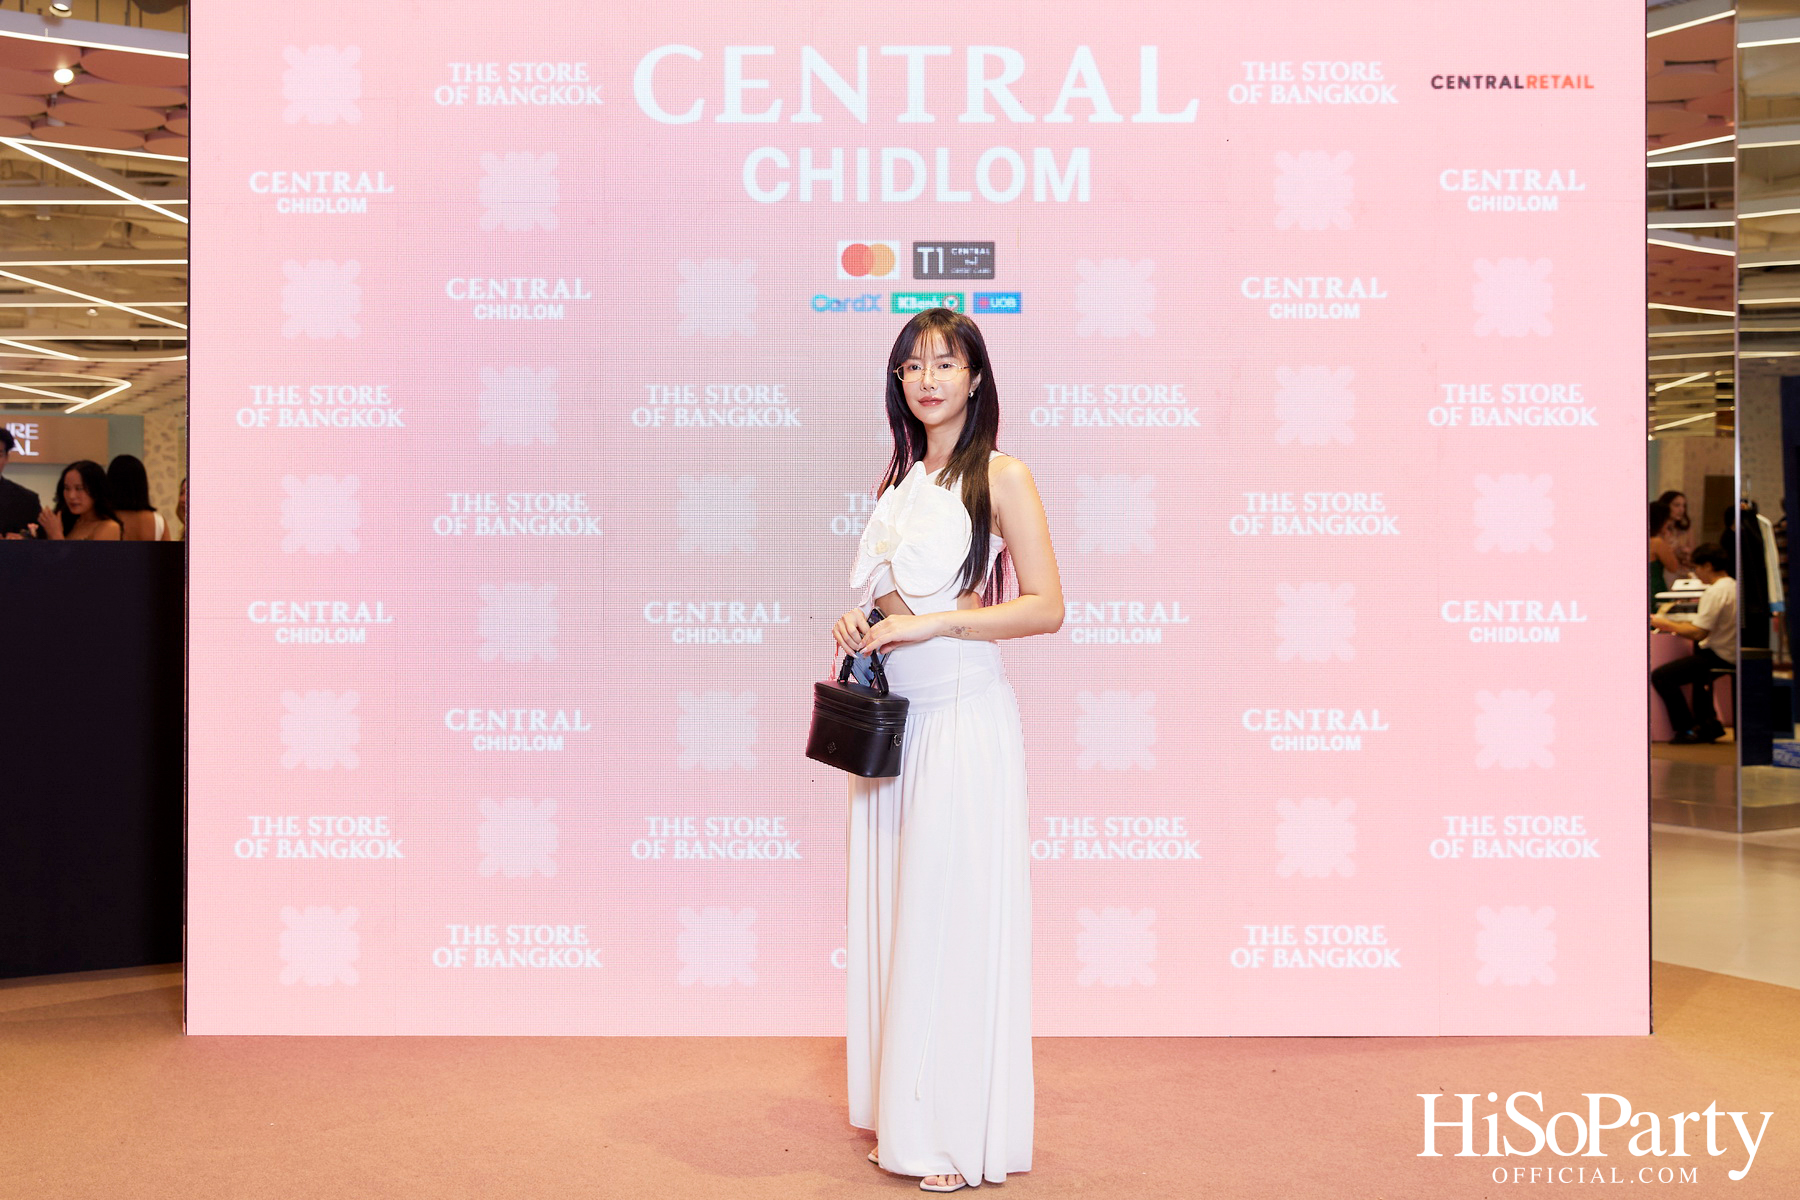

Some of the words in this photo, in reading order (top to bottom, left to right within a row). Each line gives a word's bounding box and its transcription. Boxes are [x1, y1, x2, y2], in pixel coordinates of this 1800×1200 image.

[449, 63, 501, 82] THE
[507, 62, 590, 82] STORE
[1242, 61, 1295, 82] THE
[1301, 61, 1385, 82] STORE
[633, 44, 1199, 125] CENTRAL
[1431, 75, 1595, 90] CENTRALRETAIL
[433, 85, 469, 106] OF
[475, 84, 603, 105] BANGKOK
[1227, 84, 1263, 104] OF
[1269, 83, 1399, 104] BANGKOK
[248, 171, 395, 194] CENTRAL
[742, 147, 1091, 203] CHIDLOM
[1438, 169, 1586, 192] CENTRAL
[276, 197, 368, 214] CHIDLOM
[1466, 196, 1559, 212] CHIDLOM
[917, 246, 944, 274] T1
[444, 278, 592, 300] CENTRAL
[1240, 277, 1388, 299] CENTRAL
[472, 304, 565, 320] CHIDLOM
[991, 297, 1016, 308] UOB
[1268, 303, 1361, 319] CHIDLOM
[250, 385, 303, 405] THE
[308, 385, 391, 405] STORE
[646, 385, 698, 405] THE
[705, 385, 788, 405] STORE
[1044, 384, 1097, 404] THE
[1103, 384, 1187, 405] STORE
[1441, 383, 1495, 404] THE
[1500, 383, 1585, 405] STORE
[234, 407, 270, 428] OF
[277, 407, 405, 427] BANGKOK
[630, 407, 666, 427] OF
[673, 407, 801, 427] BANGKOK
[1028, 407, 1064, 427] OF
[1072, 406, 1201, 427] BANGKOK
[1426, 406, 1463, 427] OF
[1469, 406, 1599, 427] BANGKOK
[448, 493, 500, 512] THE
[506, 493, 589, 512] STORE
[843, 493, 877, 512] TH
[1244, 492, 1297, 512] THE
[1302, 492, 1387, 512] STORE
[432, 515, 467, 536] OF
[474, 513, 602, 535] BANGKOK
[1228, 515, 1264, 535] OF
[1271, 513, 1401, 535] BANGKOK
[246, 601, 393, 623] CENTRAL
[642, 601, 791, 623] CENTRAL
[1064, 601, 1190, 624] ENTRAL
[1440, 600, 1588, 623] CENTRAL
[274, 627, 367, 643] CHIDLOM
[671, 627, 764, 644] CHIDLOM
[1071, 627, 1162, 644] CHIDLOM
[1468, 626, 1561, 643] CHIDLOM
[443, 708, 592, 731] CENTRAL
[1241, 708, 1390, 731] CENTRAL
[472, 735, 565, 751] CHIDLOM
[1269, 735, 1363, 751] CHIDLOM
[248, 816, 301, 837] THE
[307, 816, 391, 837] STORE
[646, 816, 698, 837] THE
[705, 817, 789, 837] STORE
[1044, 816, 1098, 837] THE
[1104, 817, 1188, 837] STORE
[1444, 816, 1497, 837] THE
[1502, 815, 1587, 837] STORE
[233, 838, 269, 859] OF
[275, 838, 404, 859] BANGKOK
[630, 839, 666, 859] OF
[673, 839, 802, 859] BANGKOK
[1030, 839, 1066, 859] OF
[1072, 838, 1202, 859] BANGKOK
[1428, 838, 1465, 859] OF
[1471, 838, 1600, 858] BANGKOK
[446, 924, 499, 944] THE
[505, 925, 589, 944] STORE
[1244, 925, 1298, 944] THE
[1304, 925, 1388, 944] STORE
[431, 945, 467, 967] OF
[474, 945, 603, 968] BANGKOK
[1229, 945, 1267, 968] OF
[1272, 945, 1401, 968] BANGKOK
